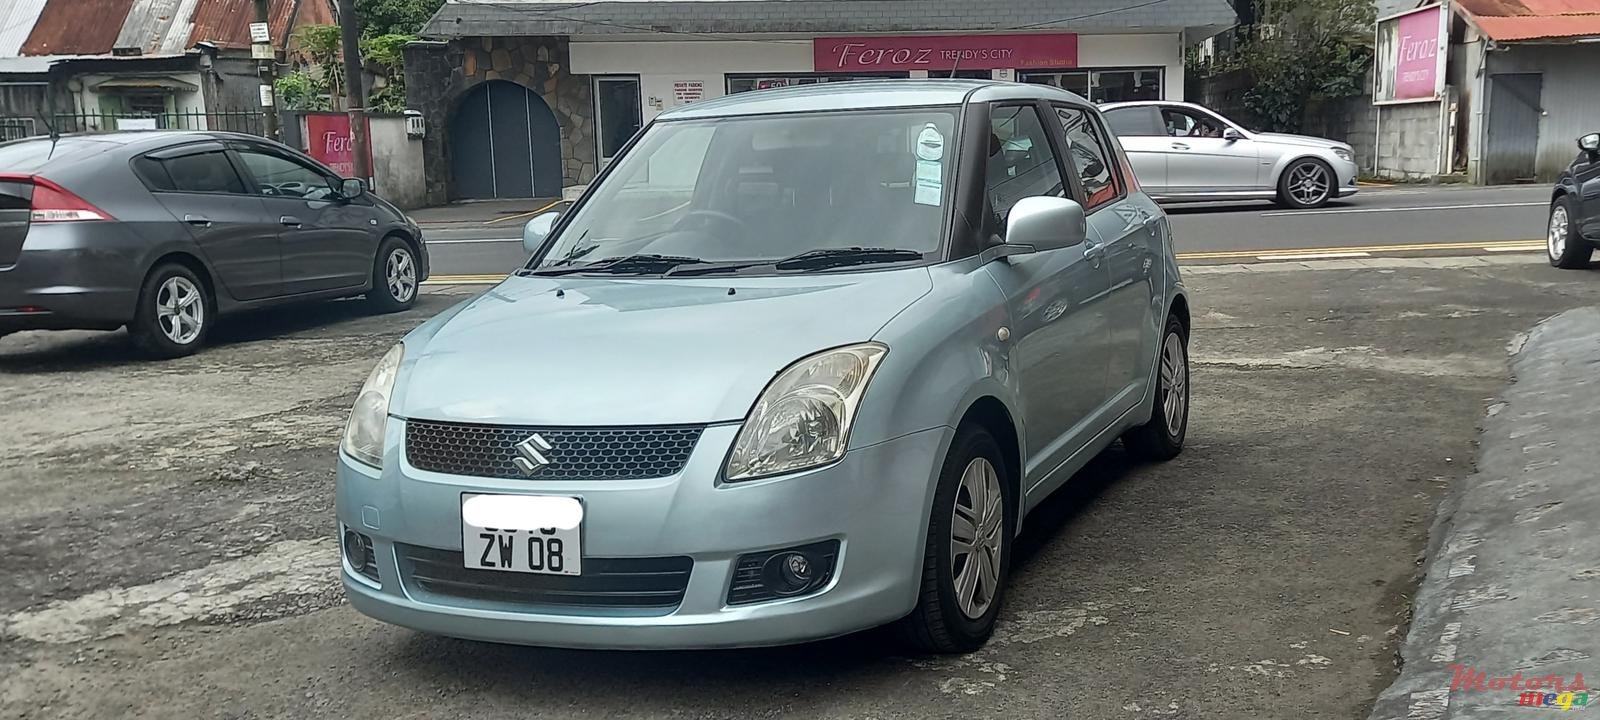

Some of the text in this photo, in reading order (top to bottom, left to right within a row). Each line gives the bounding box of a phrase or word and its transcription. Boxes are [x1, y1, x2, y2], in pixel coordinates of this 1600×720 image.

[831, 43, 1014, 68] Feroz TRENDY'S CITY
[1399, 35, 1437, 66] Feroz
[480, 533, 564, 573] ZW 08
